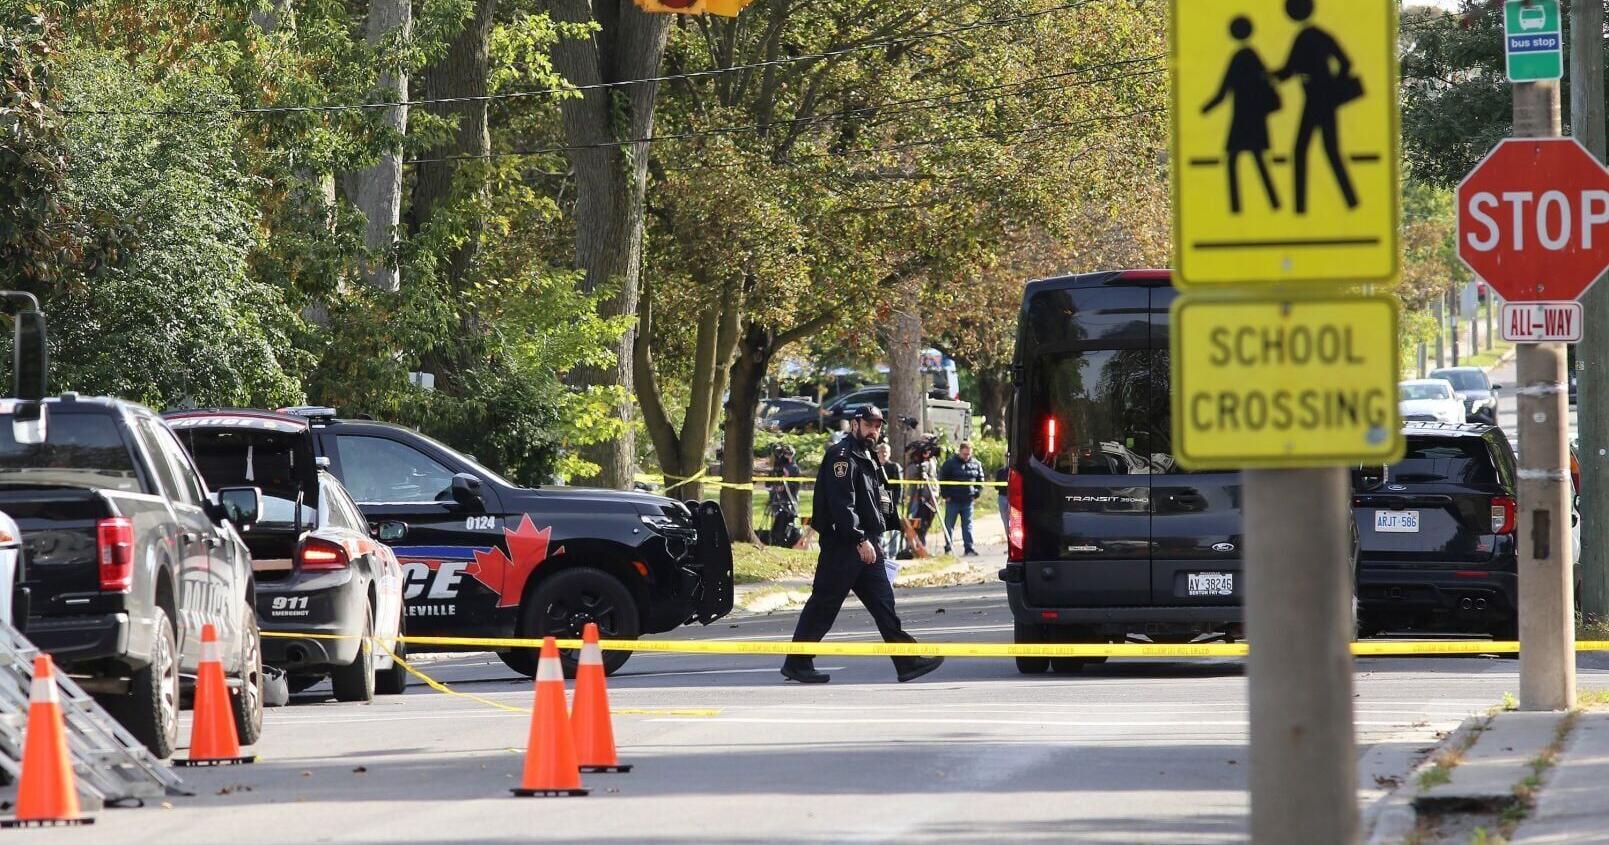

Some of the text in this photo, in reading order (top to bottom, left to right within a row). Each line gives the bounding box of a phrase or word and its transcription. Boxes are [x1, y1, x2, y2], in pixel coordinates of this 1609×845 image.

[1511, 37, 1556, 48] bus stop
[1467, 189, 1609, 252] STOP
[1510, 308, 1573, 337] ALL-WAY
[1209, 323, 1366, 368] SCHOOL
[1190, 386, 1387, 432] CROSSING
[465, 515, 496, 530] 0124
[271, 596, 309, 610] 911
